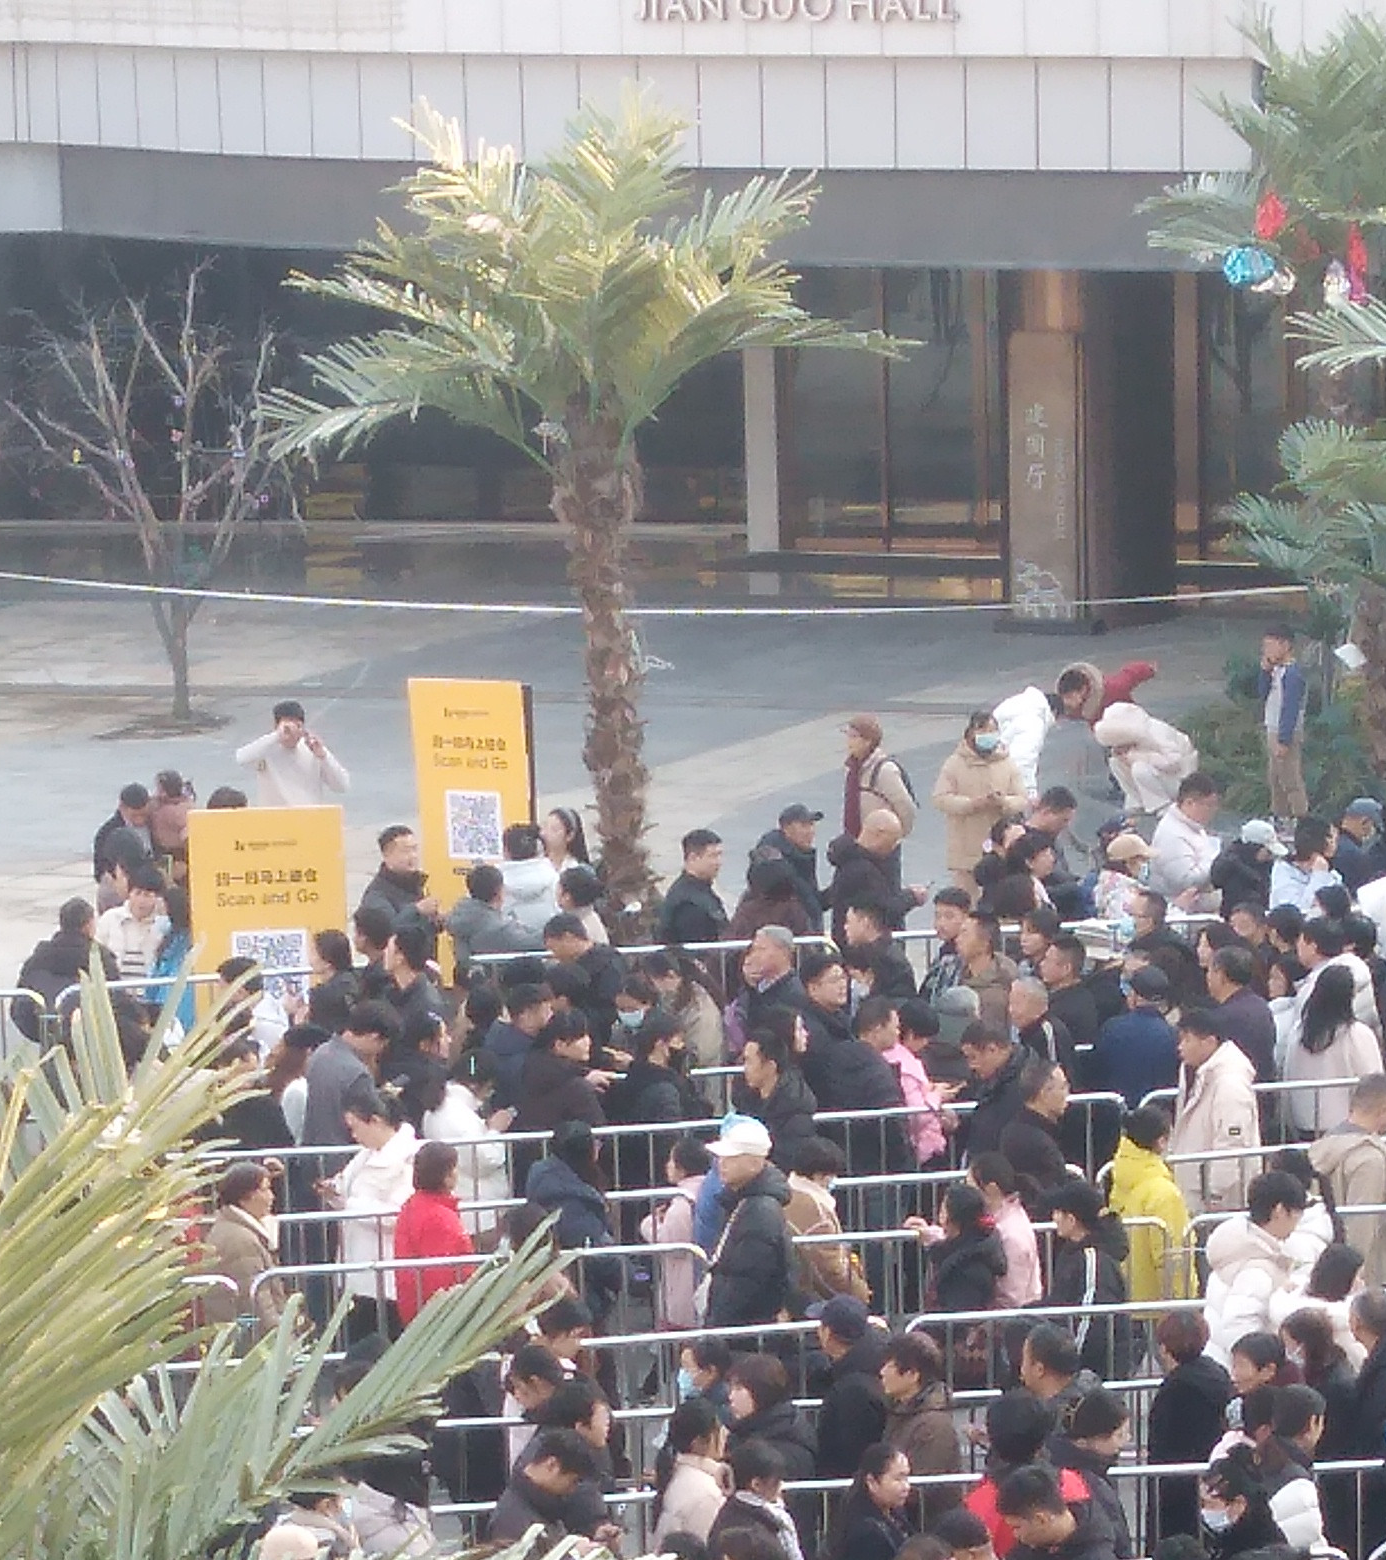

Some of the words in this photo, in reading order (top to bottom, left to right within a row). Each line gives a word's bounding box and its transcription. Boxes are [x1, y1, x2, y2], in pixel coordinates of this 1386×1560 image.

[637, 0, 728, 21] JIAN
[739, 0, 834, 21] GUO
[846, 0, 960, 21] HALL
[433, 753, 463, 767] Scan
[467, 756, 488, 768] and
[492, 756, 509, 769] Go
[217, 891, 256, 908] Scan
[262, 890, 291, 905] and
[296, 888, 320, 903] Go
